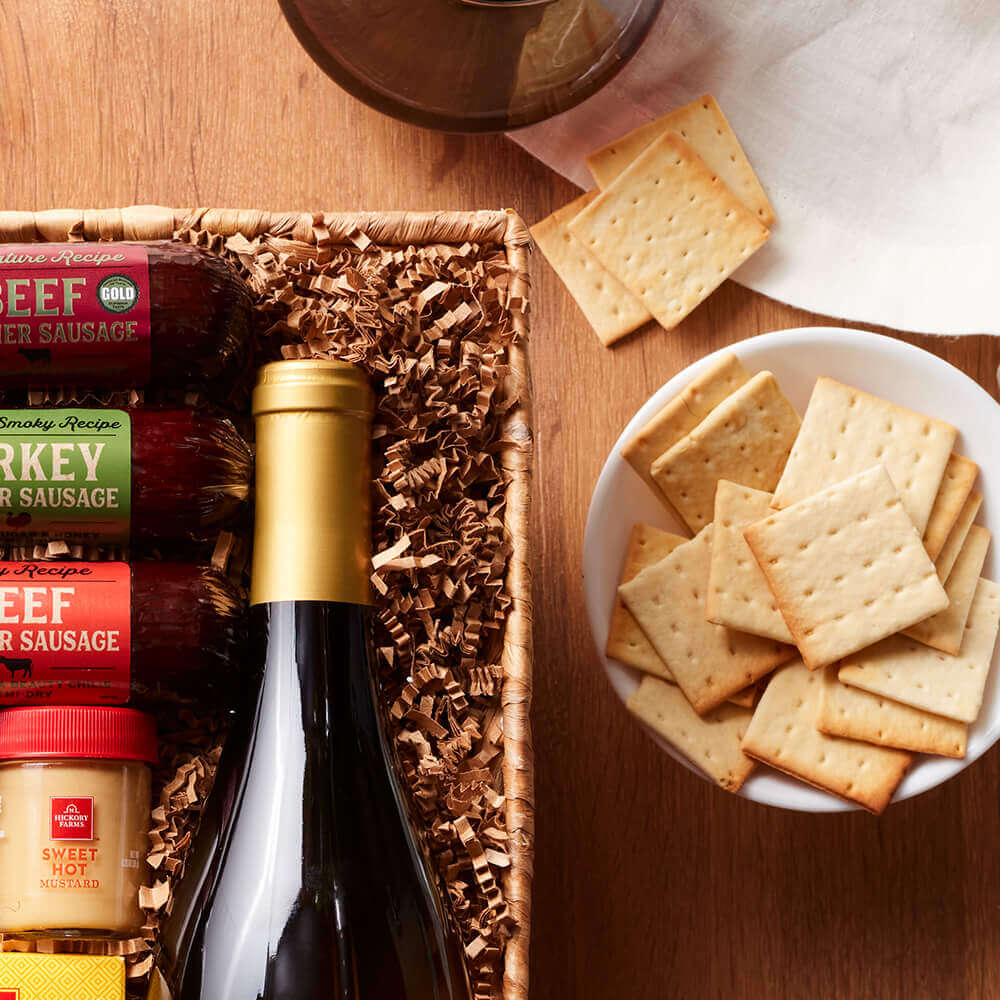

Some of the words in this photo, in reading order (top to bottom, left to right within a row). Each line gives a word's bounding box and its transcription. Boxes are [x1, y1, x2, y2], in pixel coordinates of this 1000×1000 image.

[51, 250, 126, 266] Recipe
[102, 287, 134, 300] GOLD
[39, 321, 139, 344] SAUSAGE
[58, 416, 122, 432] Recipe
[19, 487, 119, 508] SAUSAGE
[14, 564, 92, 579] Recipe
[20, 630, 119, 651] SAUSAGE
[42, 848, 98, 861] SWEET
[52, 863, 87, 876] HOT
[39, 880, 99, 889] MUSTARD
